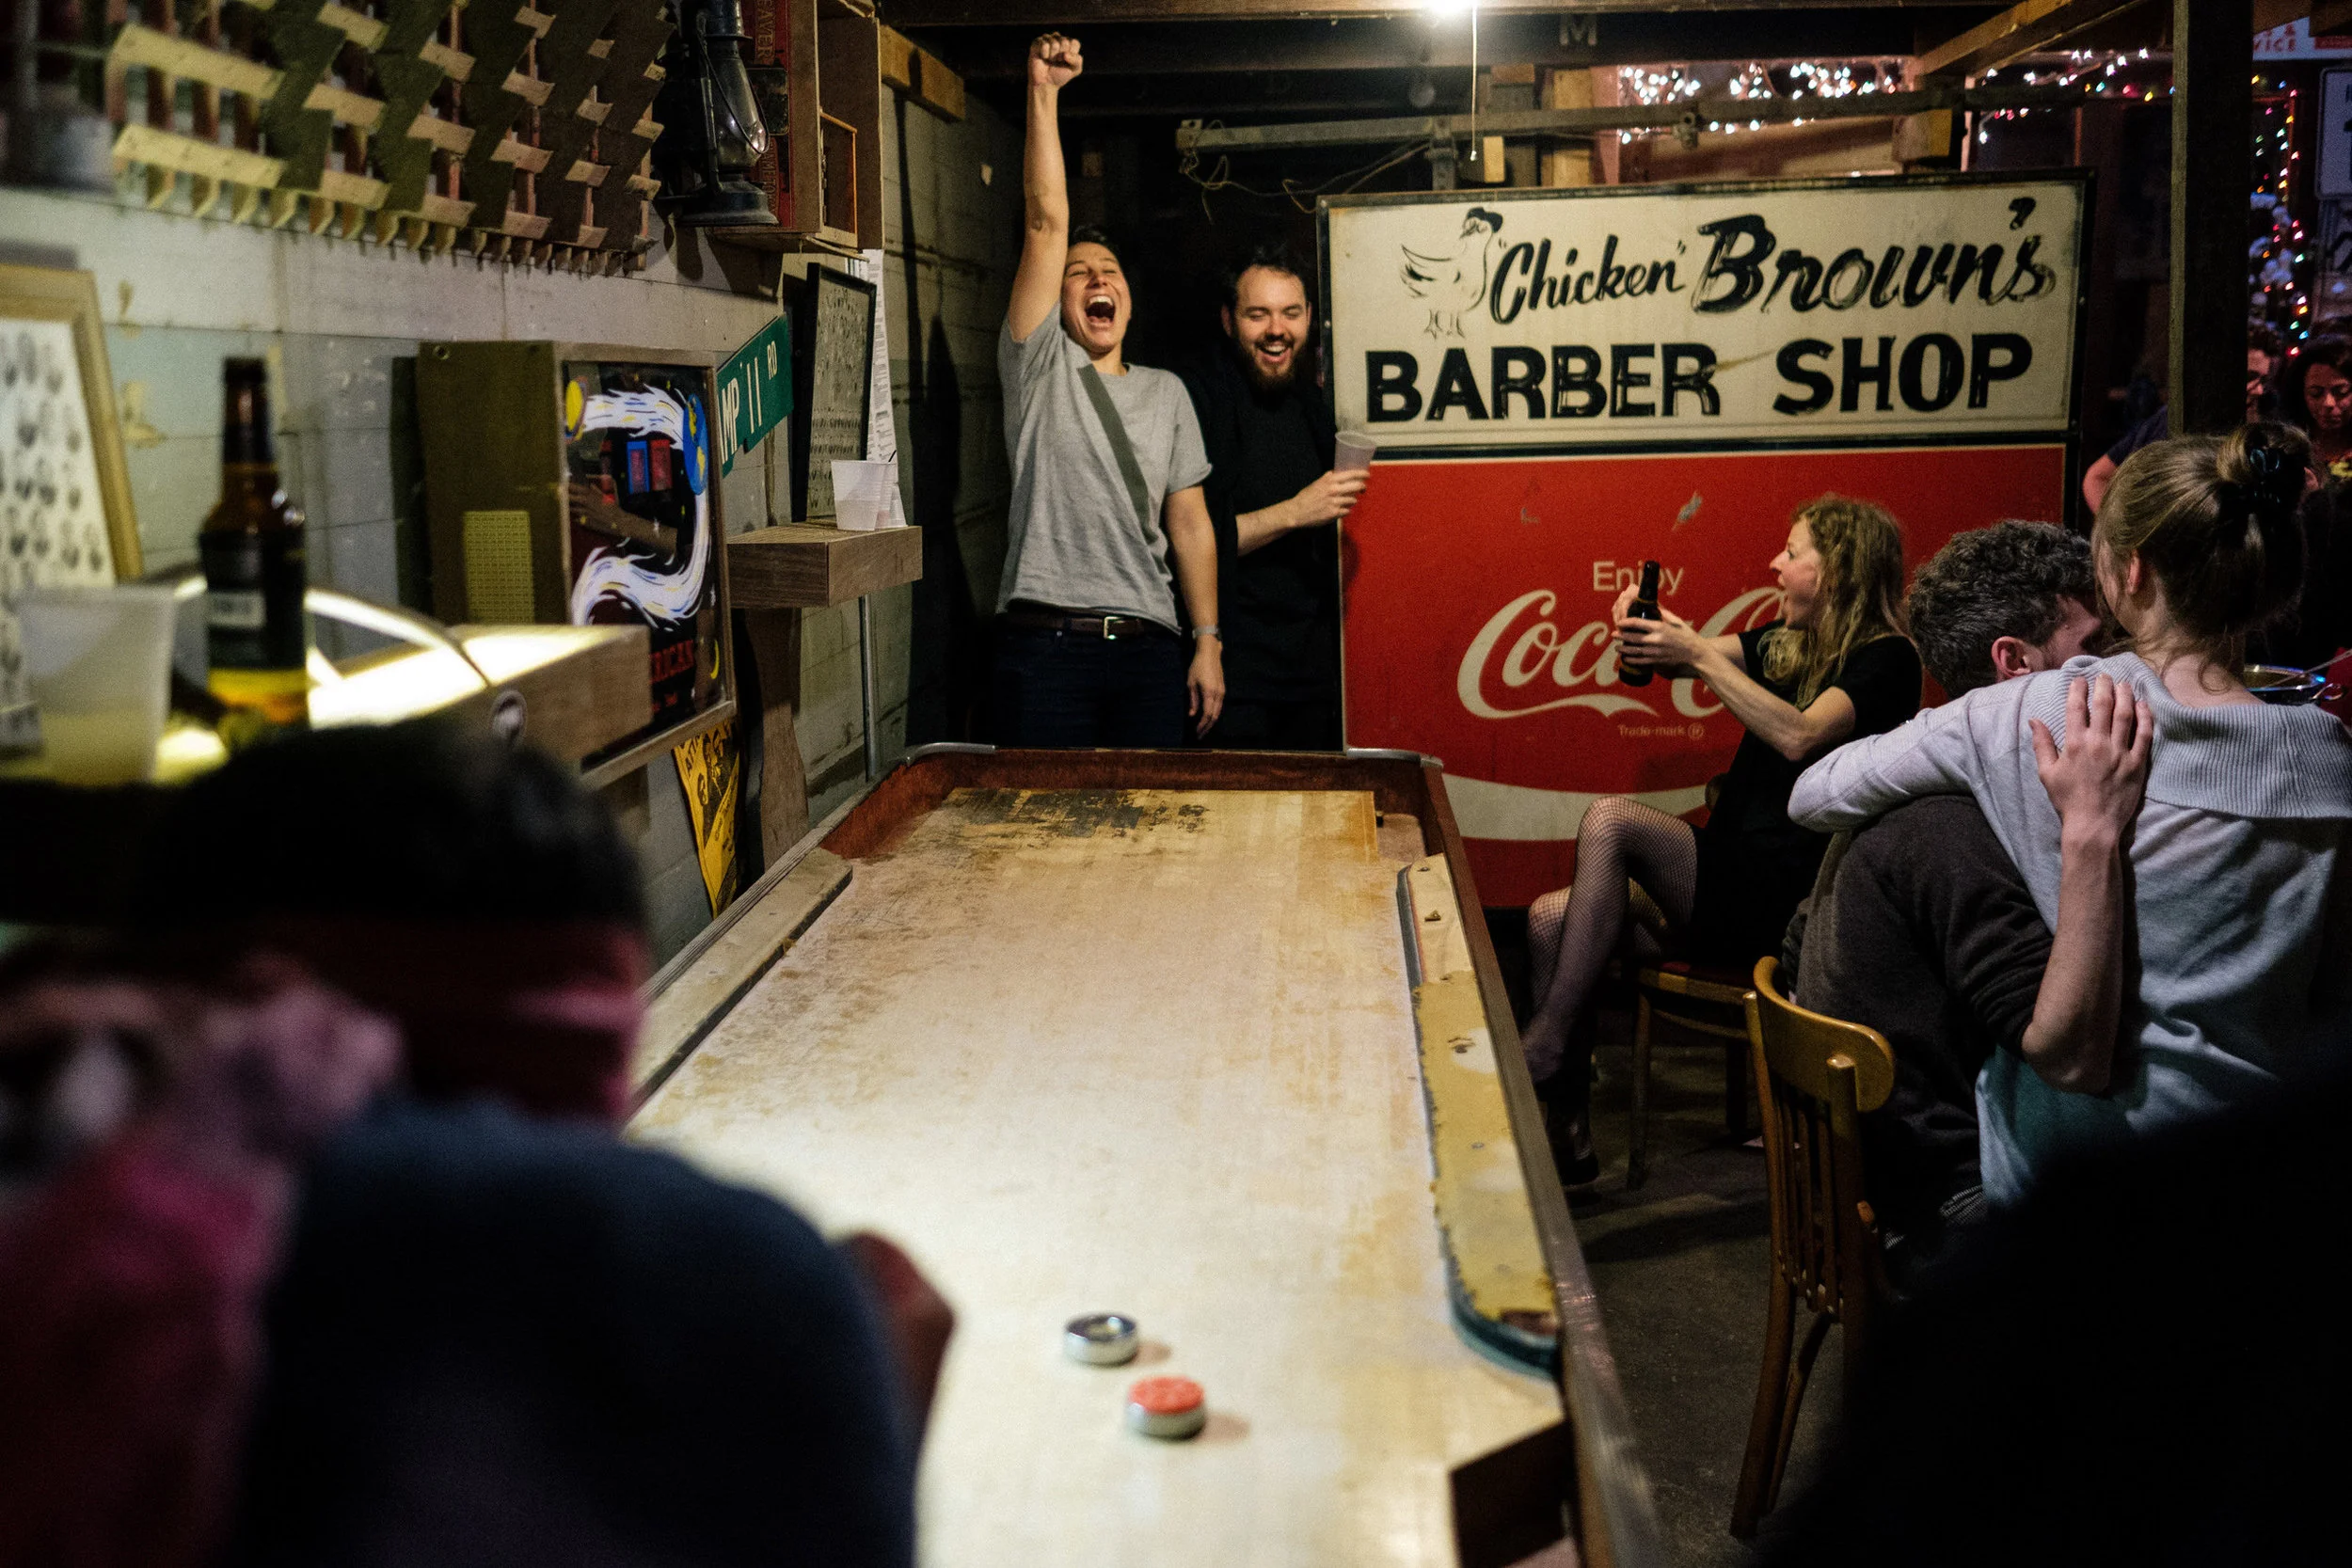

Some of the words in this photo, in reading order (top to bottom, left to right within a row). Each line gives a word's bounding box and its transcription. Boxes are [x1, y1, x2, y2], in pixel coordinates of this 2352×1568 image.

[1691, 196, 2057, 314] Brown's
[767, 340, 778, 380] RD
[1365, 341, 1722, 422] BARBER
[1772, 332, 2033, 416] SHOP
[1616, 723, 1686, 737] Trade-mark
